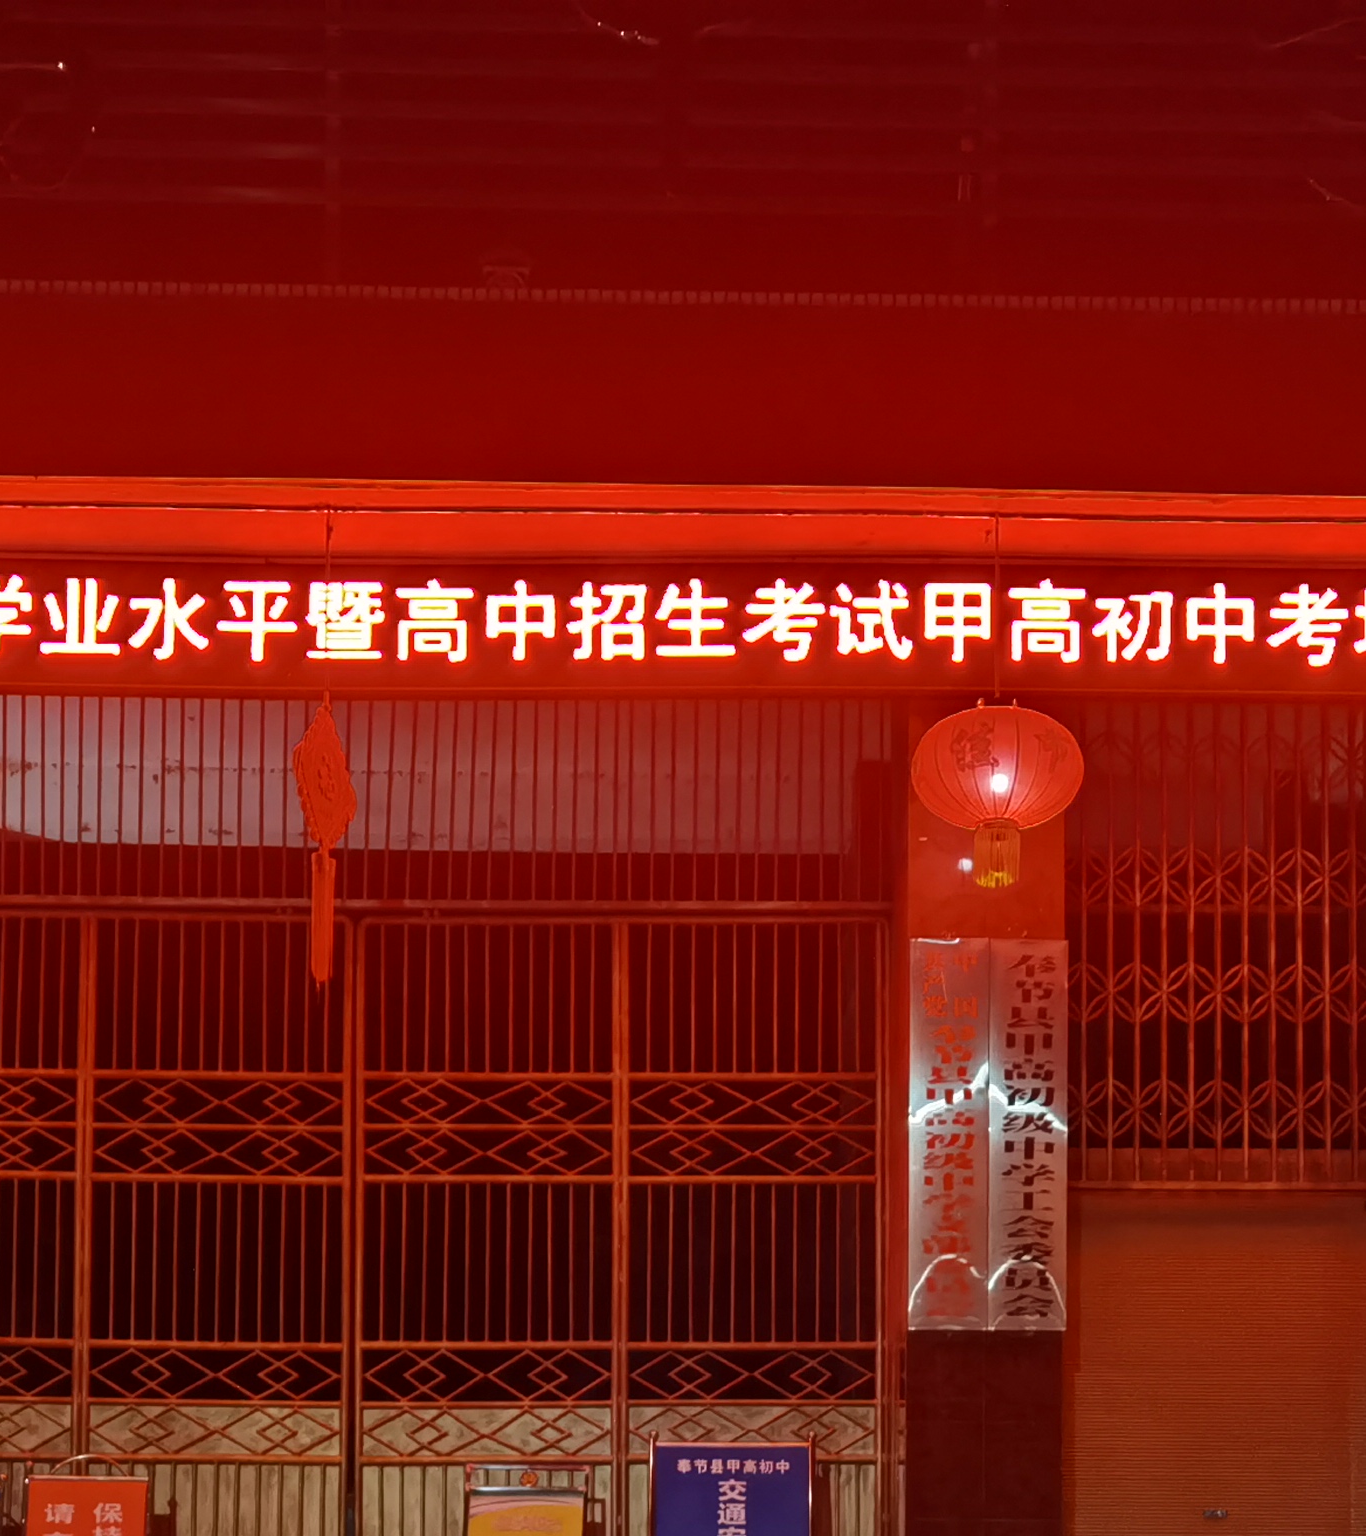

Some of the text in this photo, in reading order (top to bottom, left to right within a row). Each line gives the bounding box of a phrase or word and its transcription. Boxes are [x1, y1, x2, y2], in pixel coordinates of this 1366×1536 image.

[1001, 953, 1057, 1318] 奉节县甲高初级中学工会委员会
[676, 1458, 791, 1476] 奉节县甲高初中
